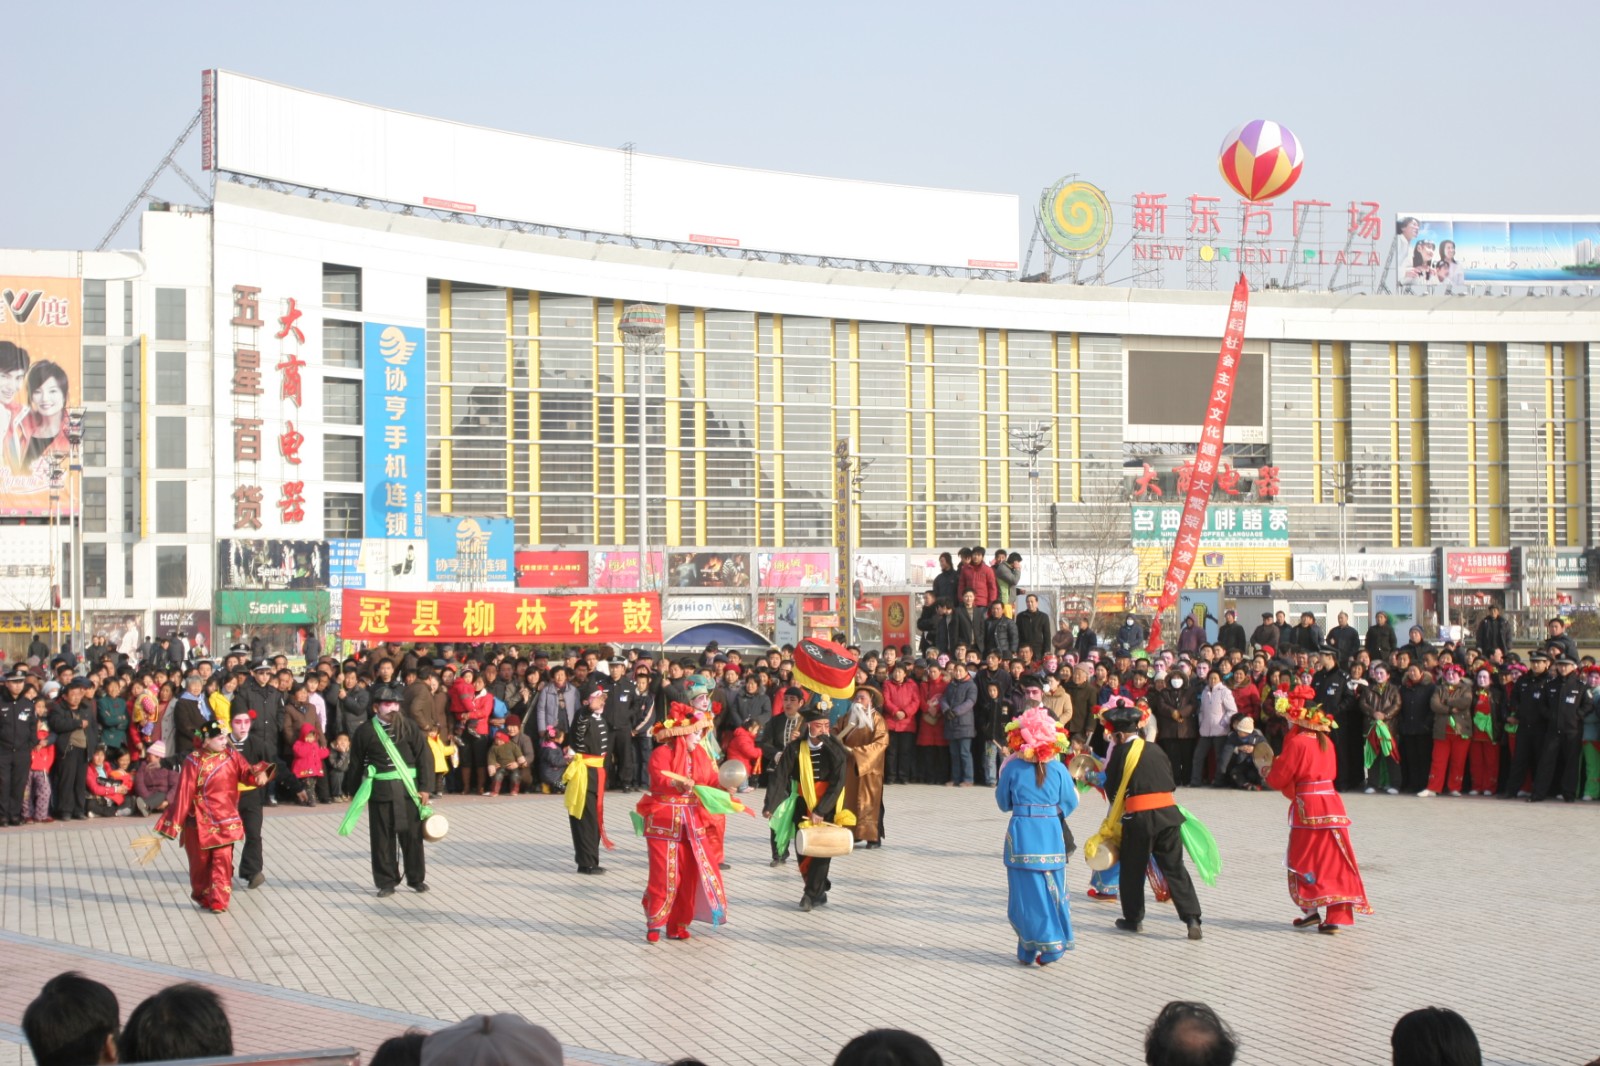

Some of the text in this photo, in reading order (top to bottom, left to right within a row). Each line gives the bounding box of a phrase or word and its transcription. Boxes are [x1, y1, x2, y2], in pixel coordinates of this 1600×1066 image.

[1134, 192, 1382, 240] 新东方广场
[1135, 244, 1381, 266] NEW ORIENT PLAZA
[232, 284, 264, 530] 五星百货
[277, 297, 306, 524] 大商电器
[384, 366, 408, 537] 协亨手机连锁
[413, 490, 423, 537] 全国连锁
[249, 600, 288, 614] Semir
[1228, 585, 1264, 596] 公安 POLICE
[358, 595, 653, 637] 冠县柳林花鼓
